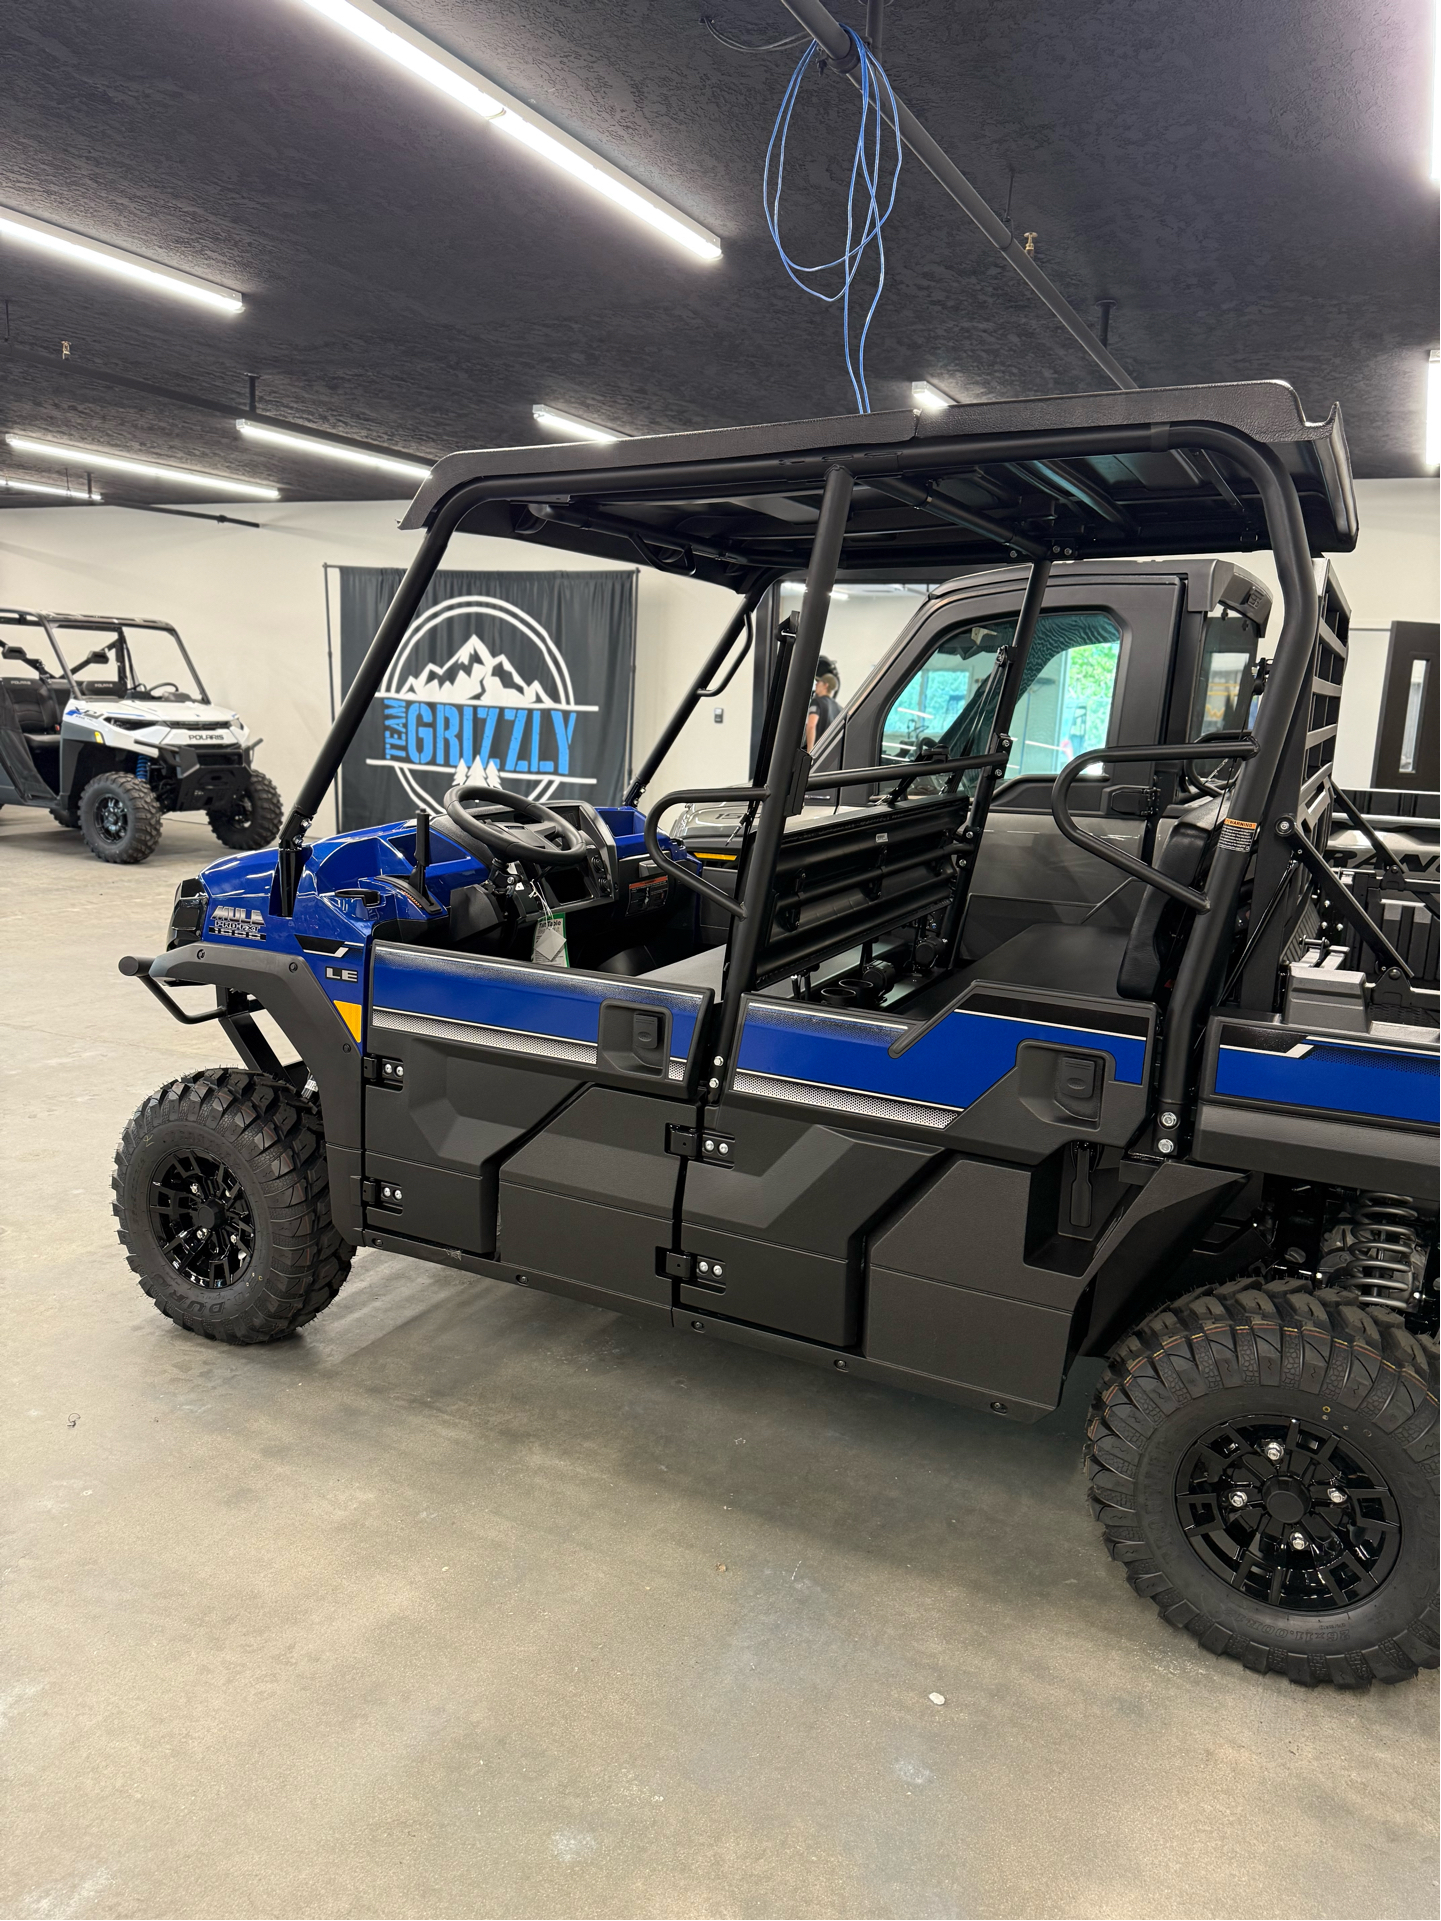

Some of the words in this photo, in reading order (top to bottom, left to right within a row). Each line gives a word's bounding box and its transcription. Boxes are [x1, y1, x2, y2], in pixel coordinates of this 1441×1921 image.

[384, 698, 406, 760] TEAM
[406, 702, 576, 774] GRIZZLY
[1230, 820, 1253, 828] WARNING
[1322, 849, 1440, 874] RAN
[211, 905, 266, 926] MULE
[326, 967, 358, 982] LE
[153, 1273, 226, 1316] DURO
